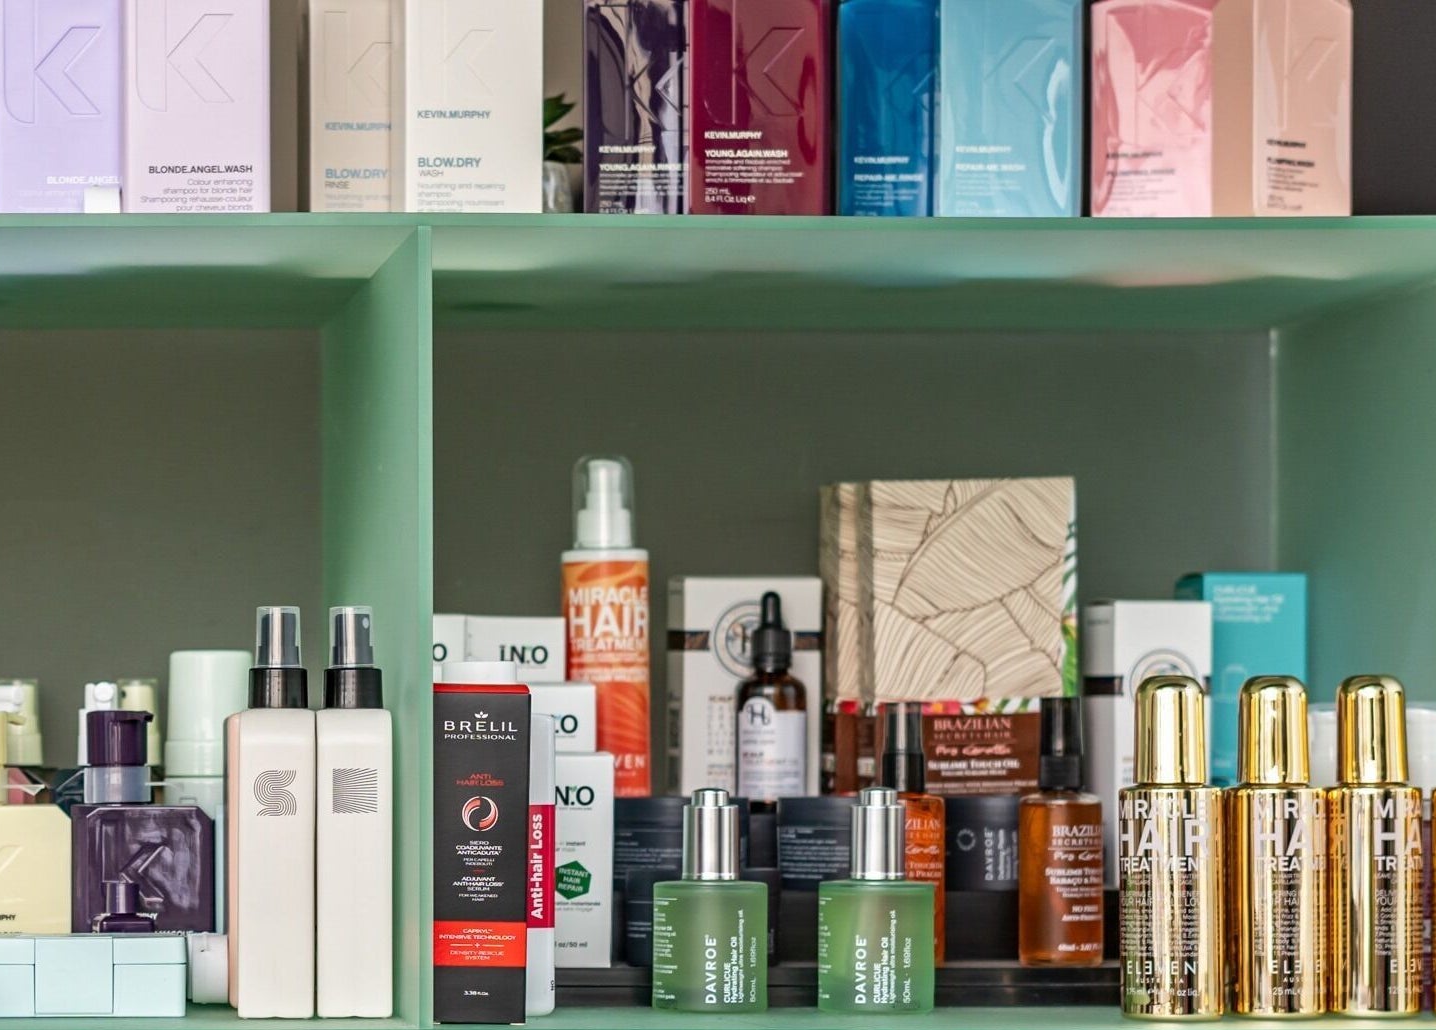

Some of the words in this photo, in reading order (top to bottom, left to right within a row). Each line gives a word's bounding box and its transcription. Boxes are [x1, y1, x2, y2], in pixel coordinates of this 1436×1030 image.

[417, 110, 491, 119] KEVIN.MURPHY
[704, 131, 762, 139] KEVIN.MURPHY
[705, 150, 788, 158] YOUNG.AGAIN.WASH
[418, 157, 481, 168] BLOW.DRY
[149, 165, 253, 174] BLONDE.ANGEL.WASH
[325, 169, 388, 179] BLOW.DRY
[188, 178, 216, 187] Colour
[569, 606, 650, 637] HAIR
[444, 721, 518, 733] BRELIL
[934, 718, 1011, 731] BRAZILIAN
[444, 733, 517, 741] PROFESSIONAL
[531, 814, 543, 849] Loss
[1120, 820, 1210, 857] HAIR
[559, 868, 589, 879] INSTANT
[530, 850, 543, 919] Anti-hair
[563, 875, 581, 884] HAIR
[557, 883, 583, 893] REPAIR
[730, 936, 738, 947] Oil
[881, 937, 889, 948] Oil
[730, 949, 738, 964] Hair
[881, 949, 889, 965] Hair
[730, 966, 738, 1003] Hydrating
[881, 966, 889, 1003] Hydrating
